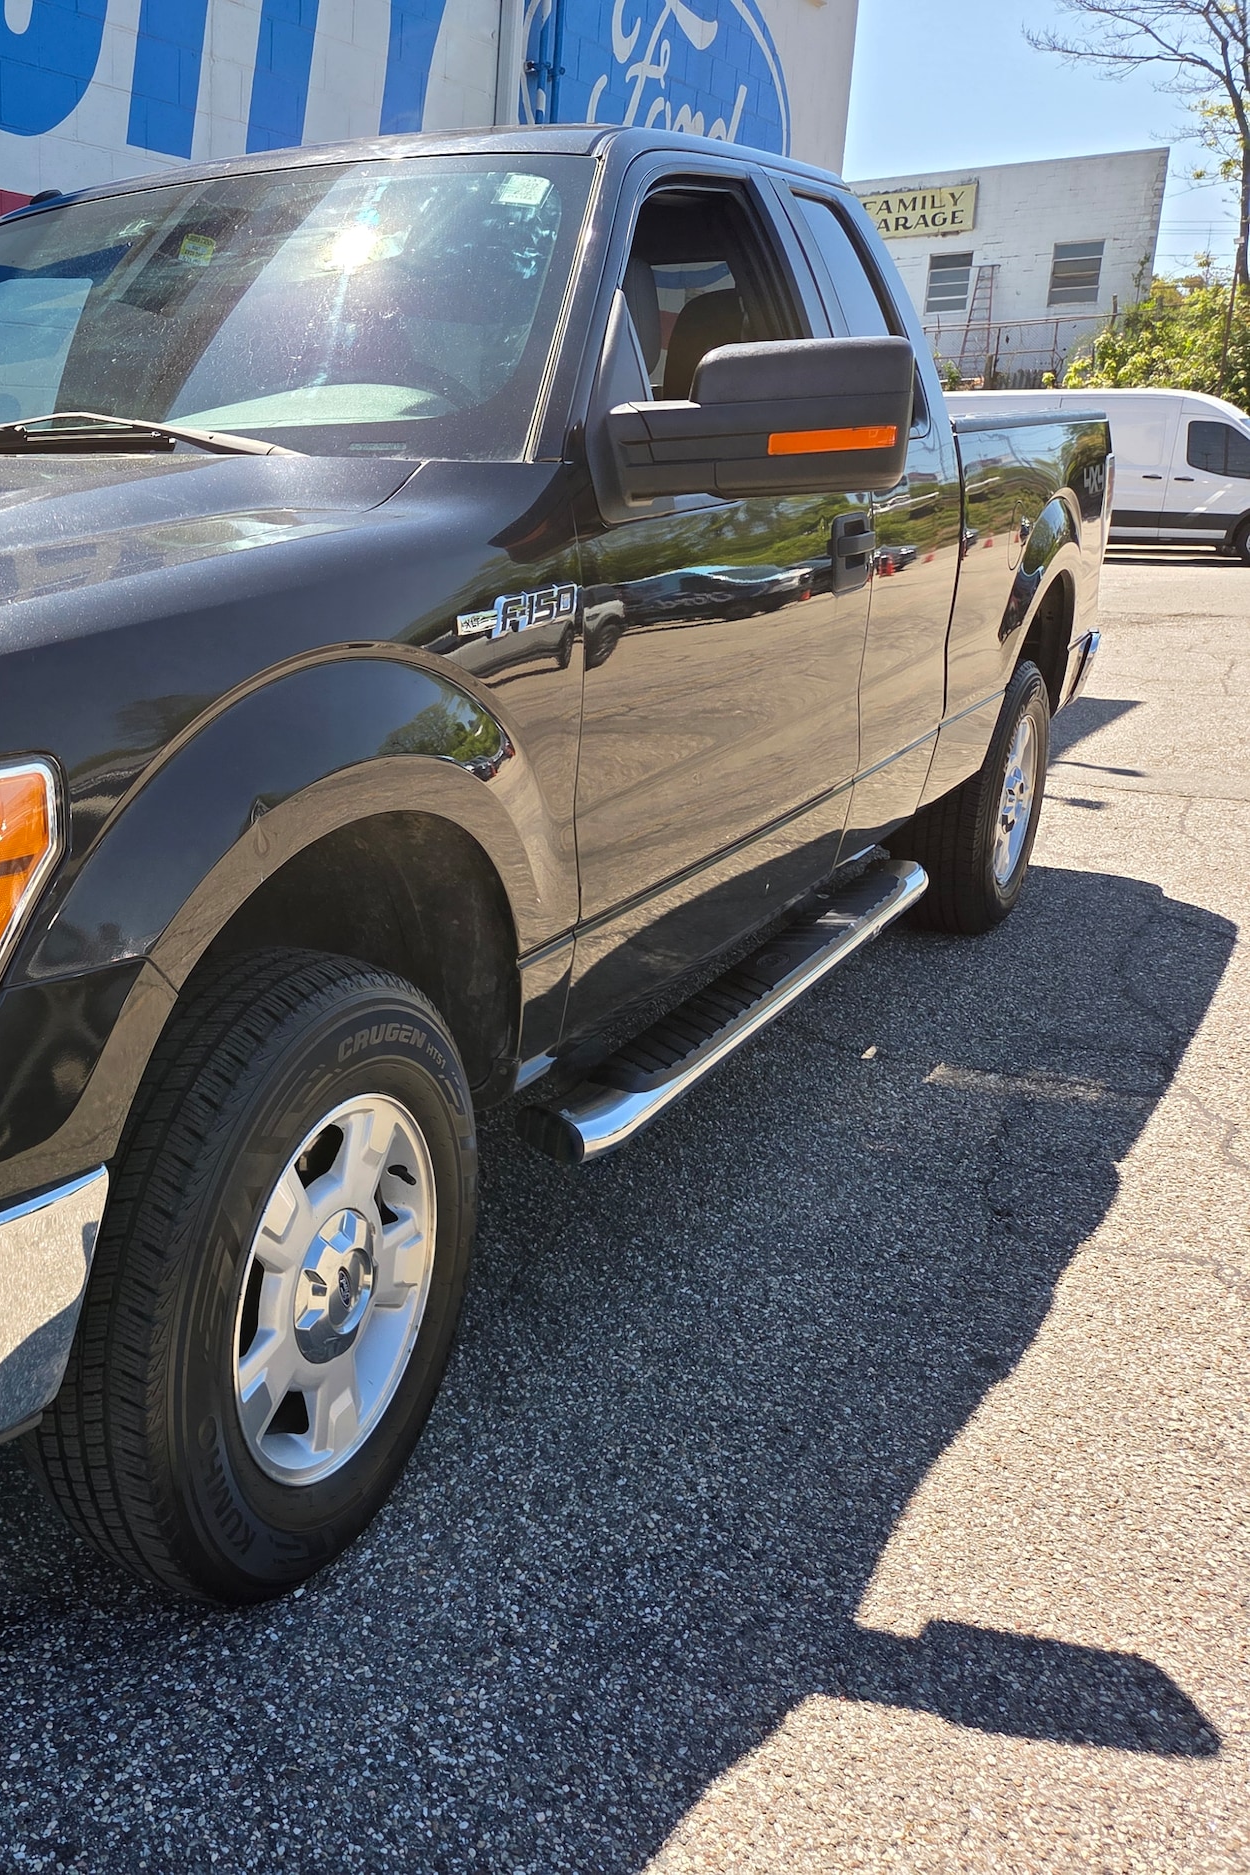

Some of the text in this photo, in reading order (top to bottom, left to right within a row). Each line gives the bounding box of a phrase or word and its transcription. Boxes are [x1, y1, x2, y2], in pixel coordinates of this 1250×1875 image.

[862, 191, 965, 215] FAMILY
[876, 209, 964, 232] ARAGE
[338, 1022, 447, 1070] CRUGEN HT51
[199, 1414, 258, 1556] KUMHO
